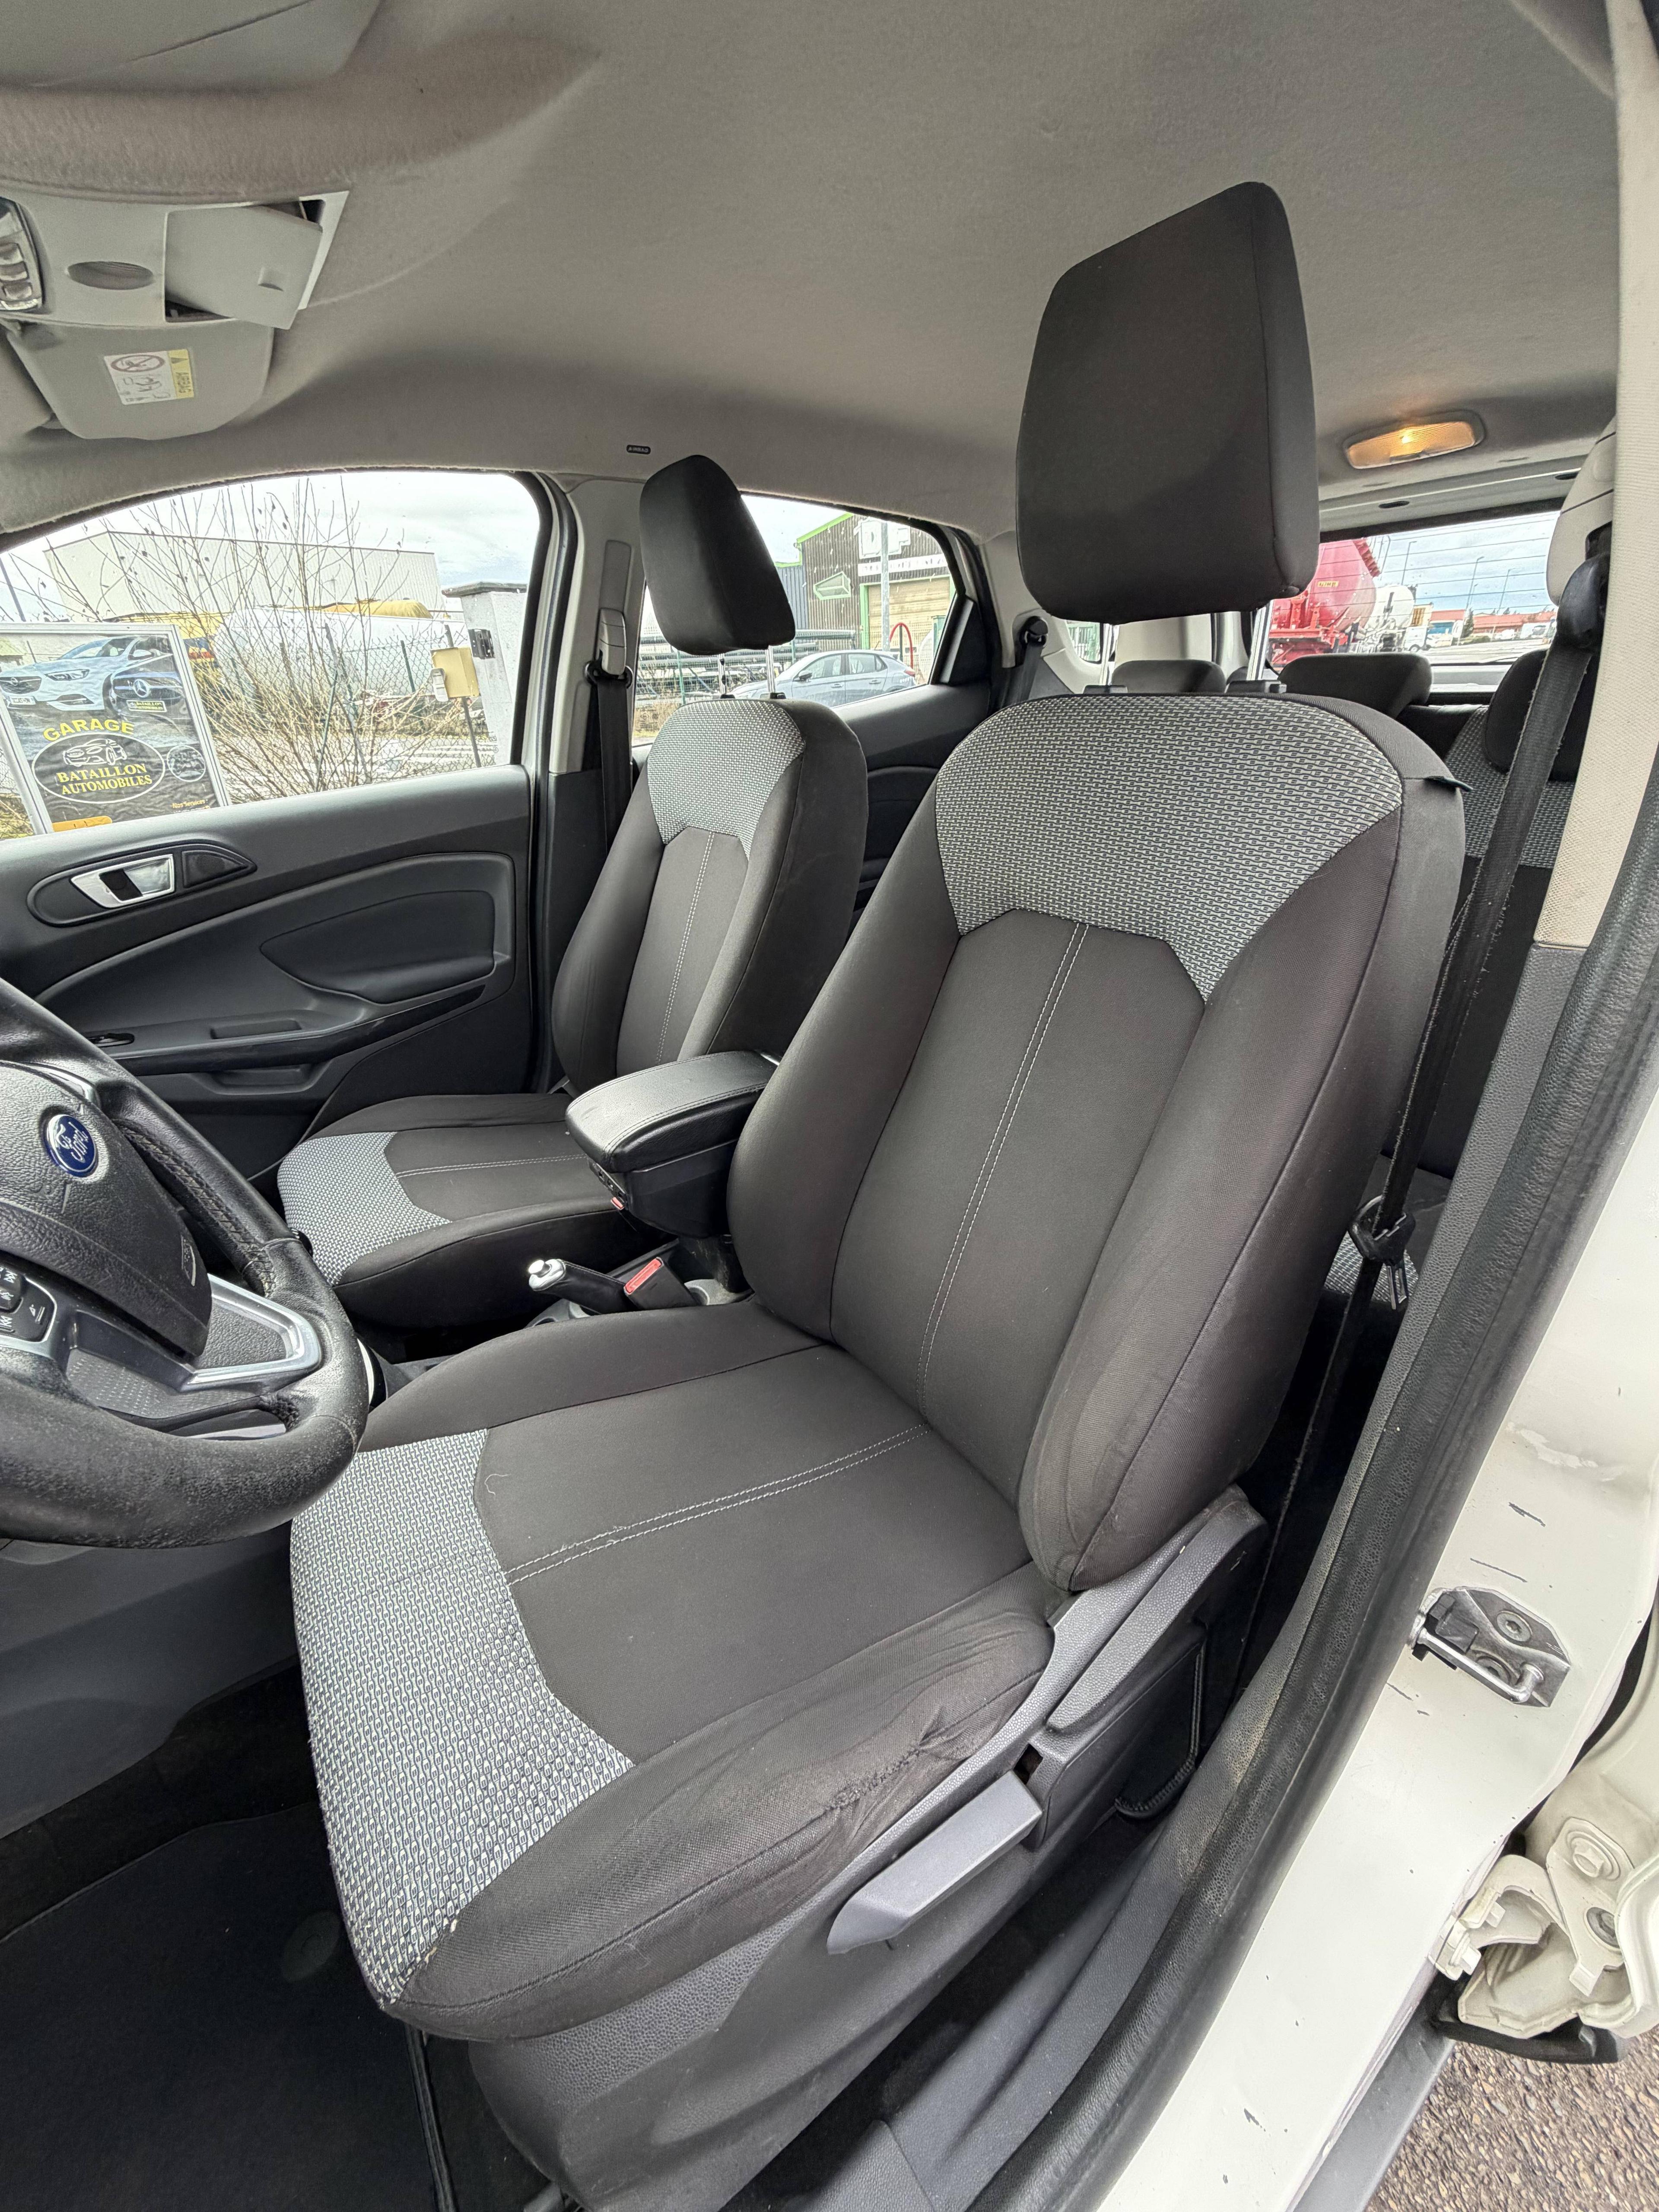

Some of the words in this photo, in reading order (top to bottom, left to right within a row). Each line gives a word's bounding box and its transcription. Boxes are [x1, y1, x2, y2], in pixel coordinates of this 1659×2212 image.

[44, 718, 135, 741] GARAGE
[56, 763, 147, 783] BATAILLON
[62, 775, 153, 795] AUTOMOBILES
[56, 1122, 89, 1163] Ford
